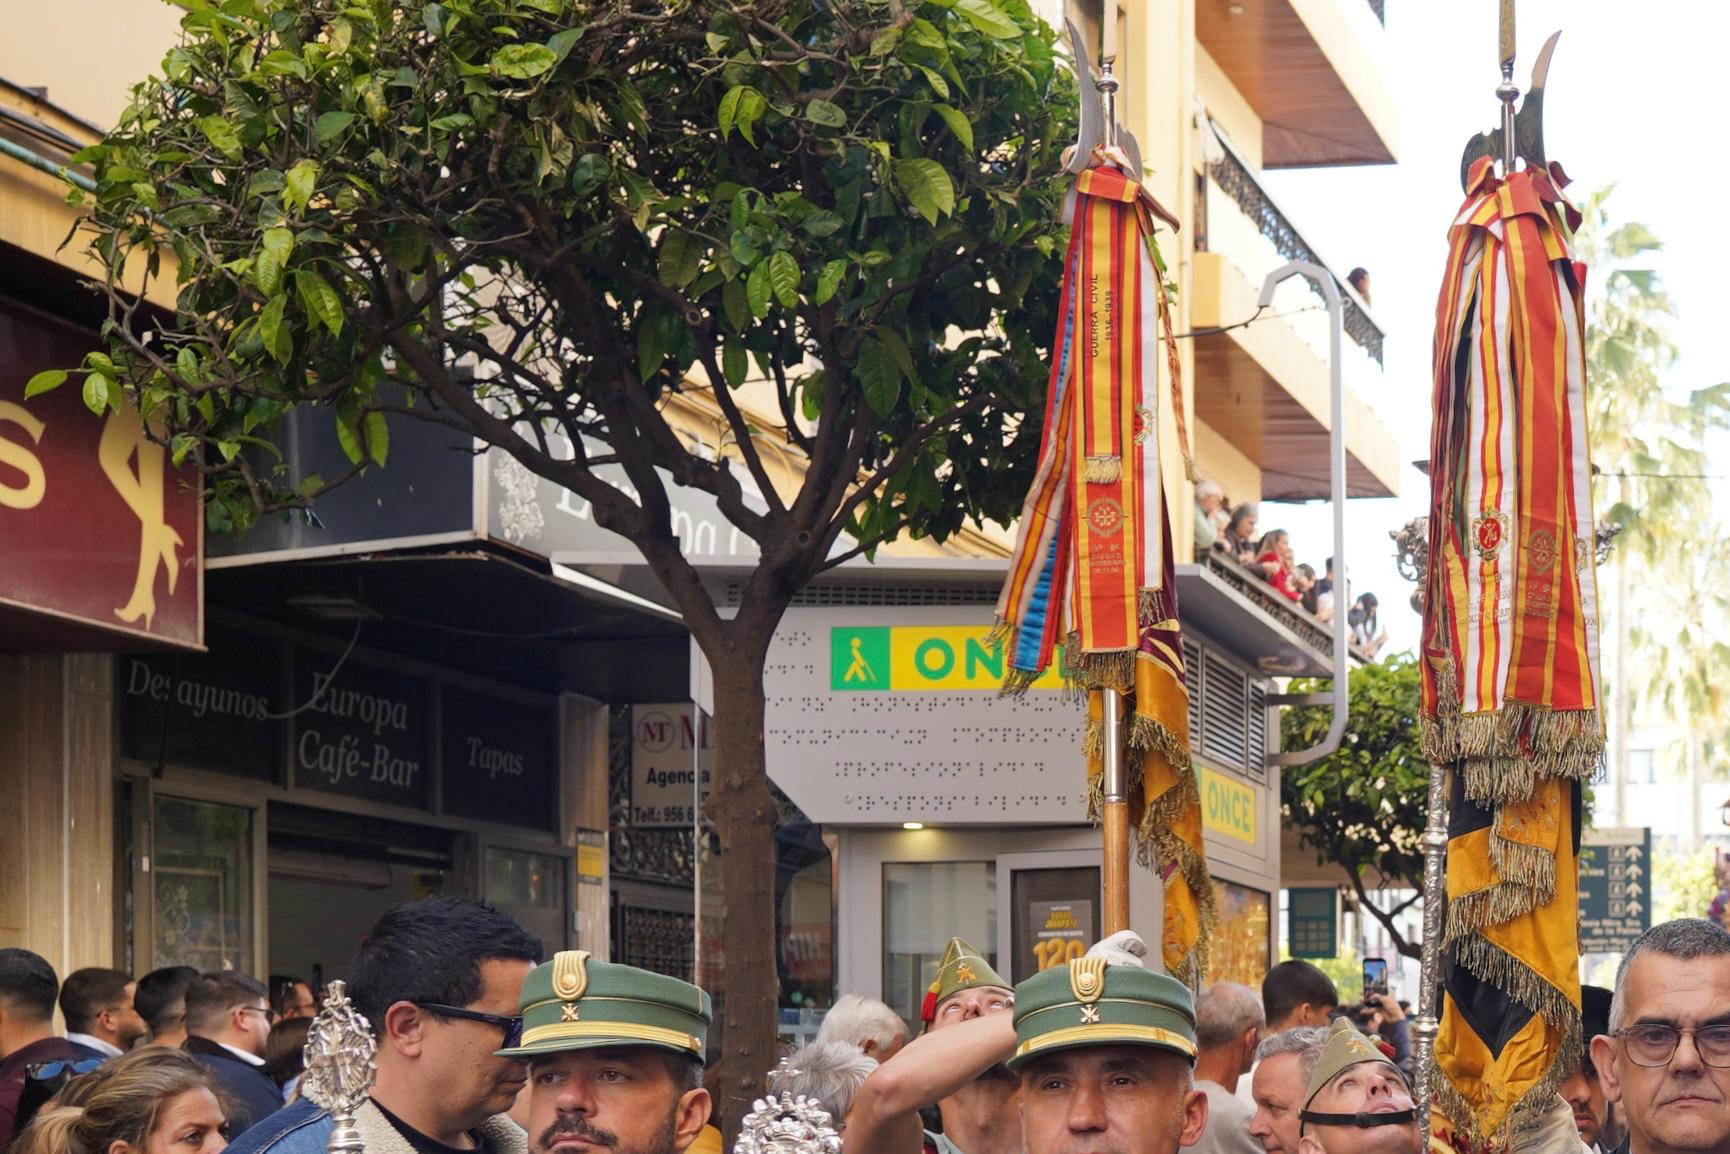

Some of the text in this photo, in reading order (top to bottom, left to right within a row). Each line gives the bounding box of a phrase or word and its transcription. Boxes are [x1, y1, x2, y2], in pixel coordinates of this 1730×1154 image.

[1091, 311, 1099, 358] GUERRA
[308, 672, 409, 737] Europa
[298, 727, 420, 790] Café-Bar
[466, 736, 524, 779] Tapas
[646, 766, 710, 787] Agenca
[1207, 779, 1250, 834] ONCE
